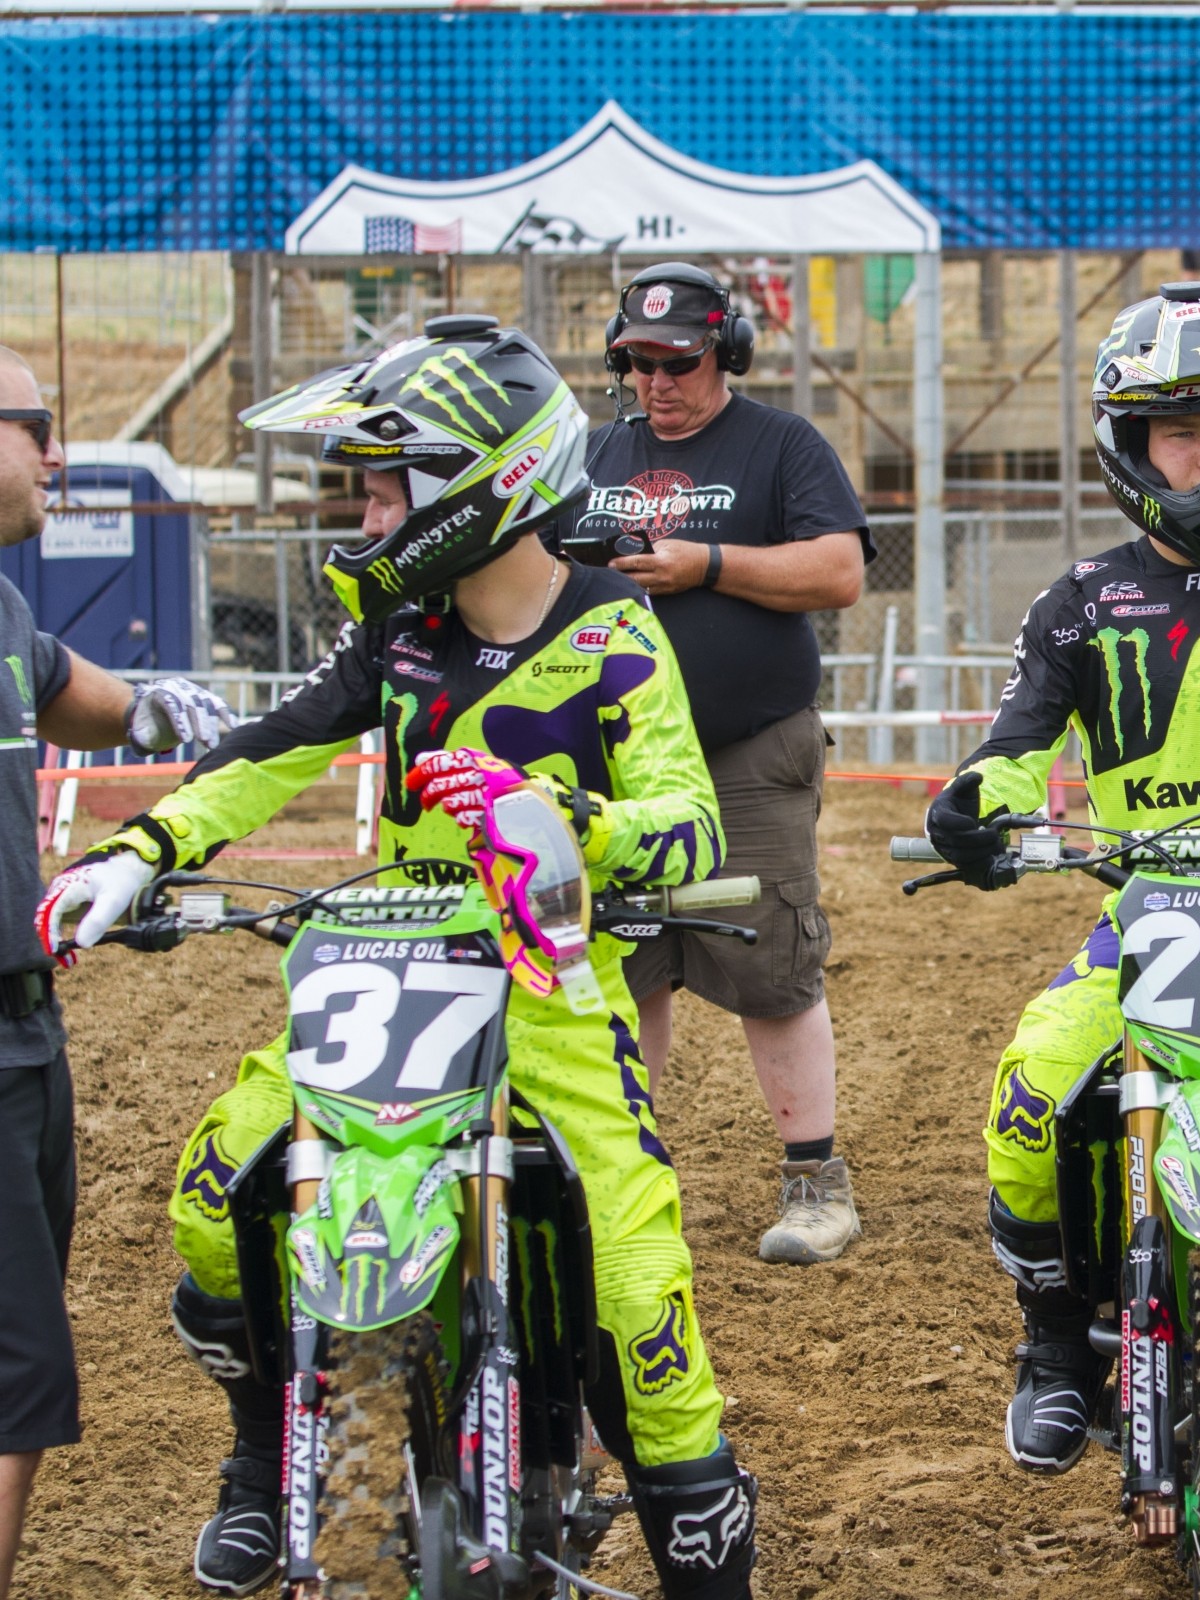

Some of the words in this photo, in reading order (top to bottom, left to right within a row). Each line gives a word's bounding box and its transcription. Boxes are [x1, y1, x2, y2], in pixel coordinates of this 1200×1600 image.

[501, 454, 539, 489] BELL
[586, 482, 736, 520] Hangtown
[395, 504, 482, 569] MONSTER
[586, 518, 656, 531] Motocross
[665, 518, 719, 530] Classic
[1100, 592, 1146, 602] RENTHAL
[1051, 627, 1080, 646] 360
[475, 648, 515, 670] FOX
[544, 665, 591, 674] SCOTT
[610, 924, 663, 937] ARC
[342, 942, 410, 961] LUCAS
[412, 942, 448, 961] OIL
[286, 961, 509, 1091] 37
[1129, 1135, 1147, 1195] PRO
[1128, 1249, 1152, 1264] 360
[1121, 1311, 1131, 1412] BRAKING
[1132, 1335, 1152, 1472] UNLOP
[484, 1366, 509, 1553] DUNLOP
